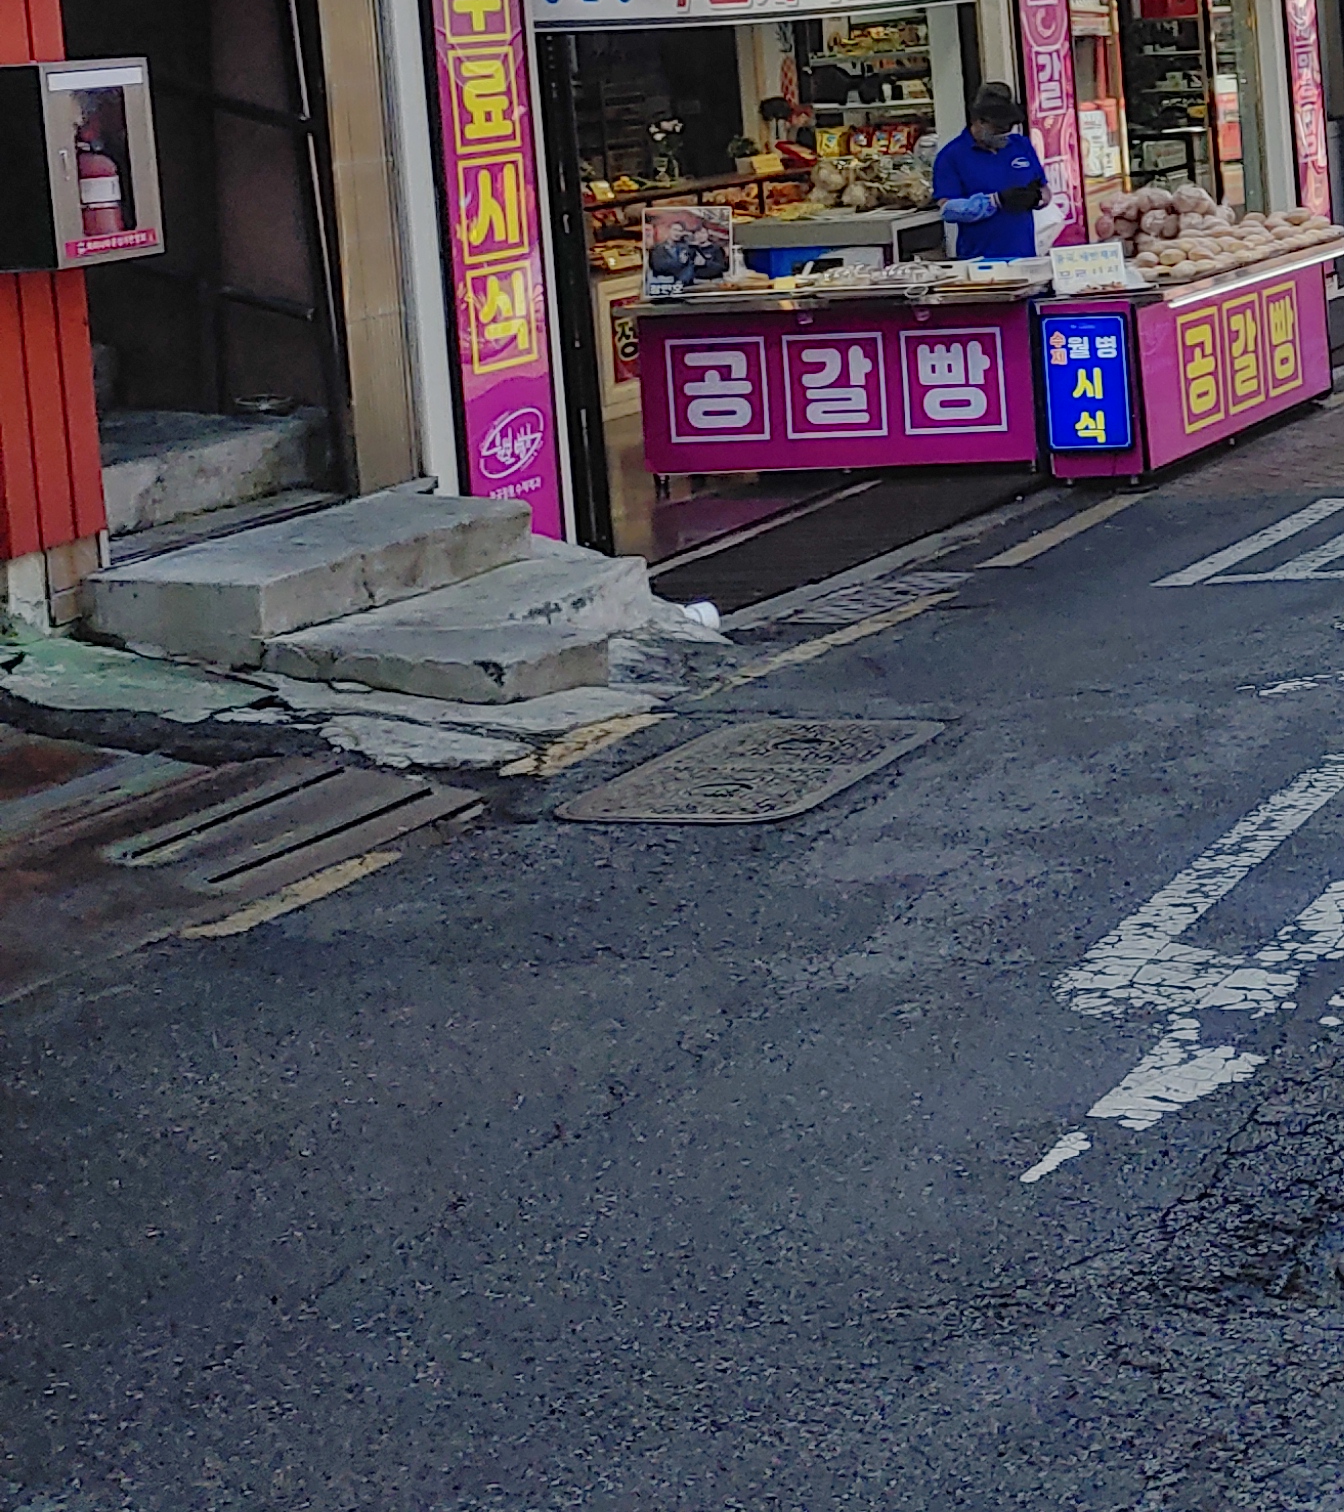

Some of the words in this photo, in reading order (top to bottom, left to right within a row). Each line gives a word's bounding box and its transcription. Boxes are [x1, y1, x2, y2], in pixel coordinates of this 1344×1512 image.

[683, 340, 991, 430] 공갈빵
[1067, 335, 1118, 359] 월병
[1183, 299, 1298, 416] 공갈빵
[1072, 366, 1107, 444] 시식
